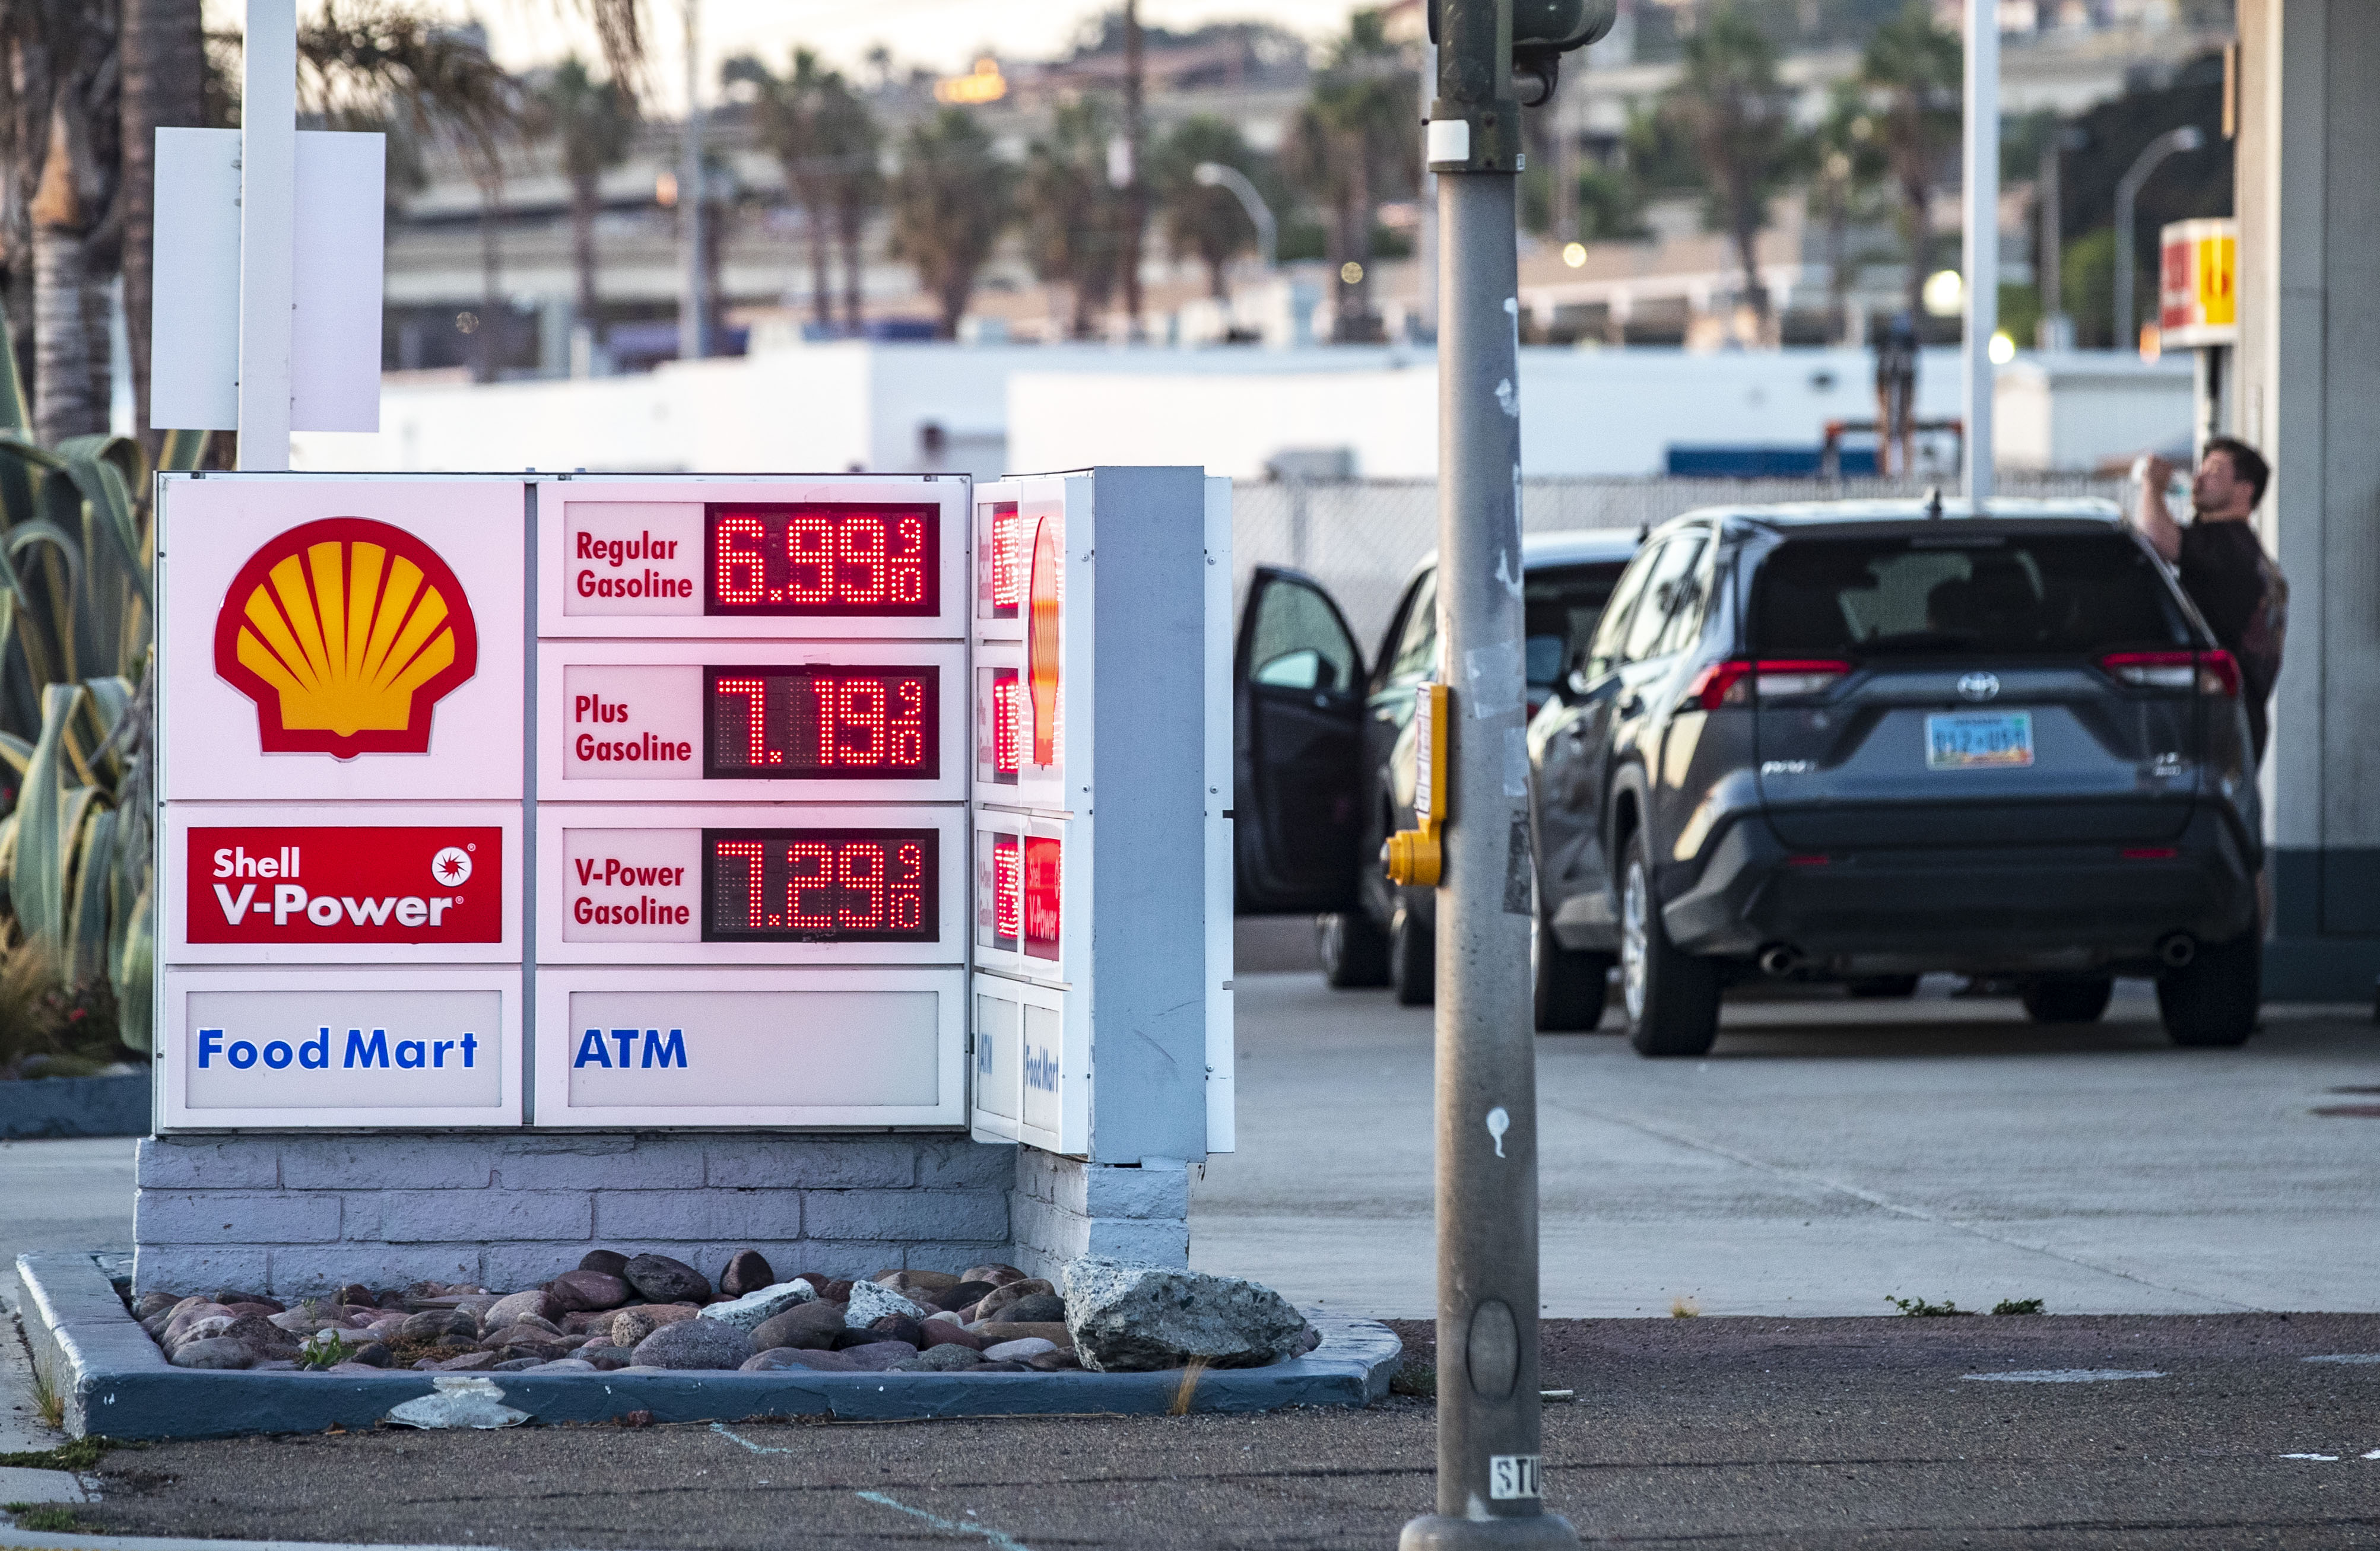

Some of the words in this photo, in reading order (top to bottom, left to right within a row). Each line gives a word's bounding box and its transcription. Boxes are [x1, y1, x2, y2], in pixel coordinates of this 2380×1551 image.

[577, 530, 678, 565] Regular
[718, 517, 886, 603] 6.99
[577, 568, 693, 599] Gasoline
[575, 694, 629, 724] Plus
[718, 680, 886, 765] 7.19
[576, 731, 692, 762] Gasoline
[212, 846, 300, 878] Shell
[574, 858, 685, 887] V-Power
[717, 843, 884, 928] 7.29
[573, 895, 690, 926] Gasoline
[198, 1027, 329, 1069] Food
[343, 1029, 478, 1069] Mart
[573, 1029, 688, 1069] ATM
[1026, 1045, 1042, 1089] Food
